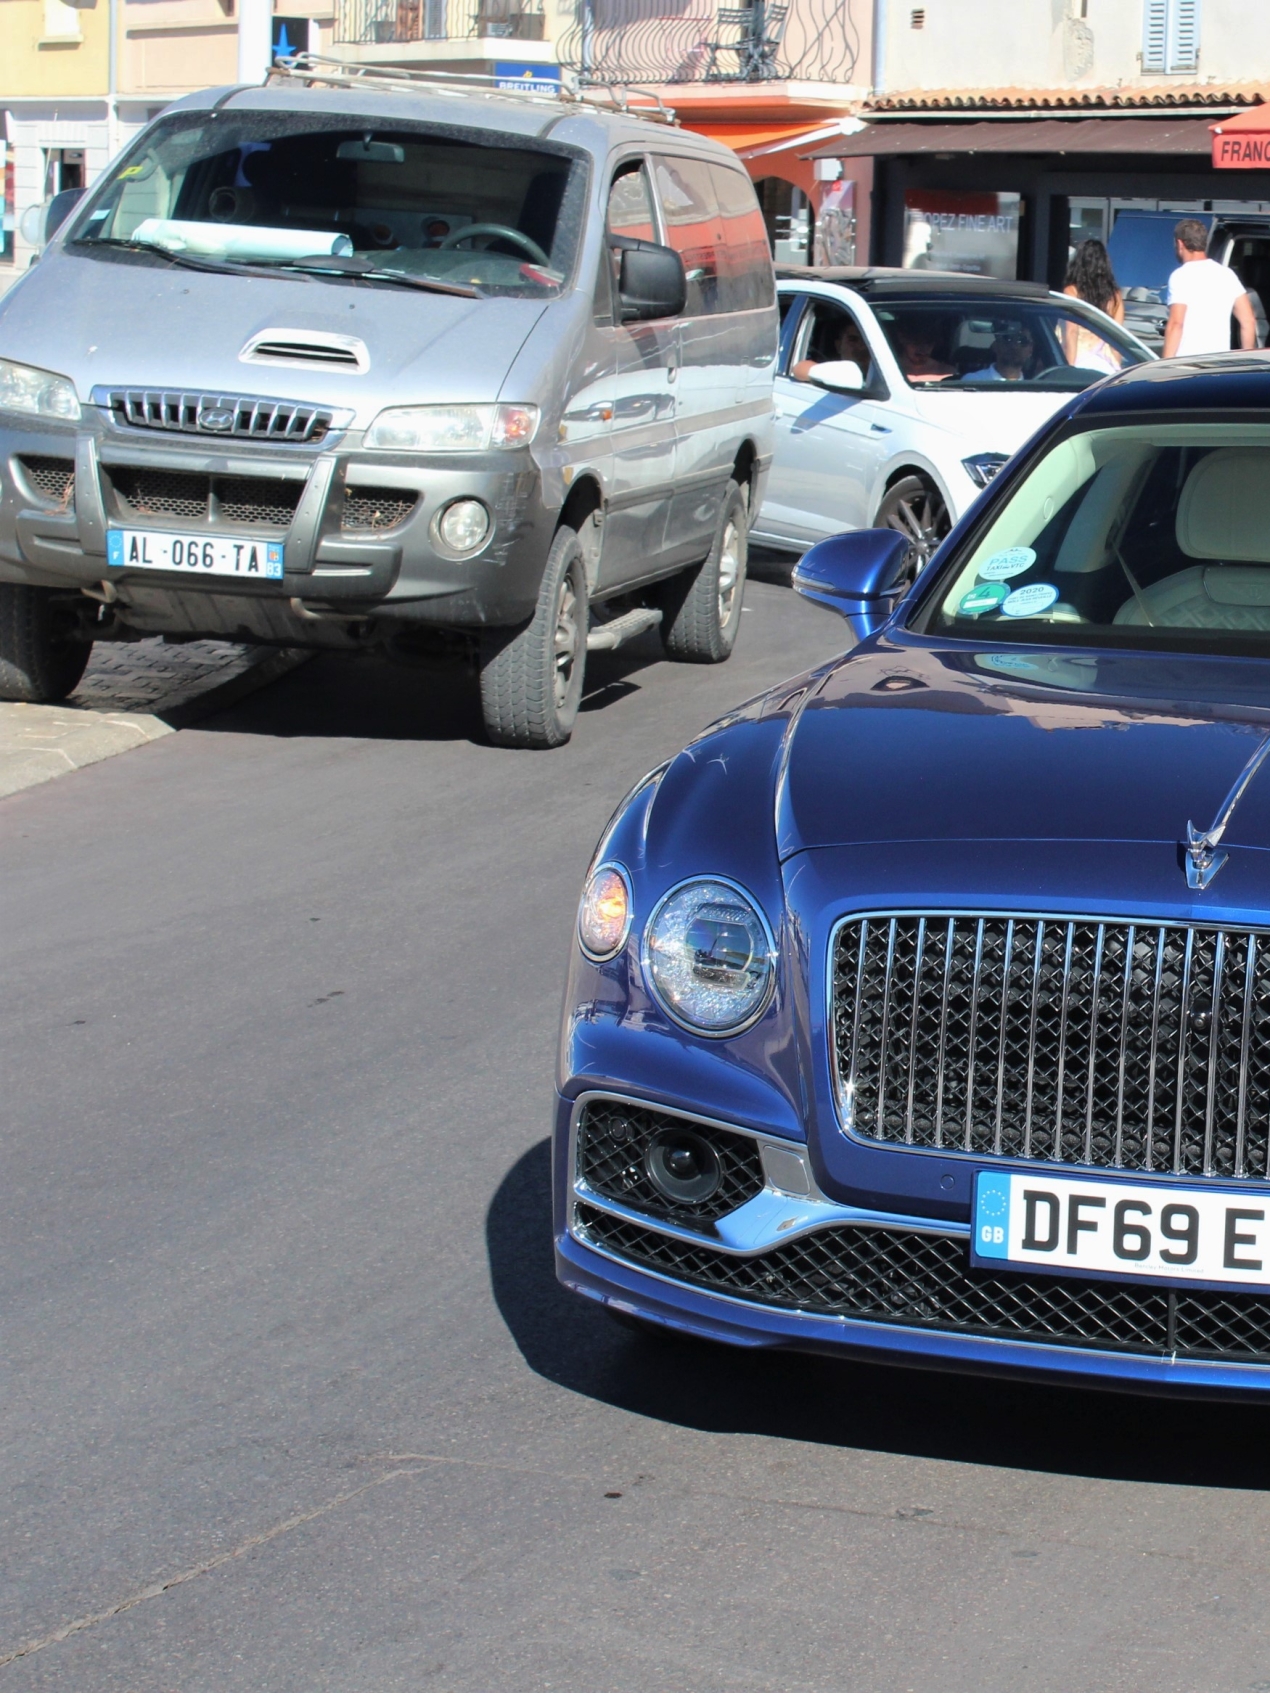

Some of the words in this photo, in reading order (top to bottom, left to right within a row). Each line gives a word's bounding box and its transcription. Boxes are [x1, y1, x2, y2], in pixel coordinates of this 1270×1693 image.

[499, 81, 556, 93] BREITLING
[957, 213, 985, 232] FINE
[986, 216, 1013, 233] ART
[112, 551, 120, 560] F
[989, 555, 1029, 566] PASS
[267, 562, 282, 577] 83
[1020, 586, 1045, 595] 2020
[1022, 1189, 1200, 1265] DF69
[981, 1225, 1004, 1244] GB
